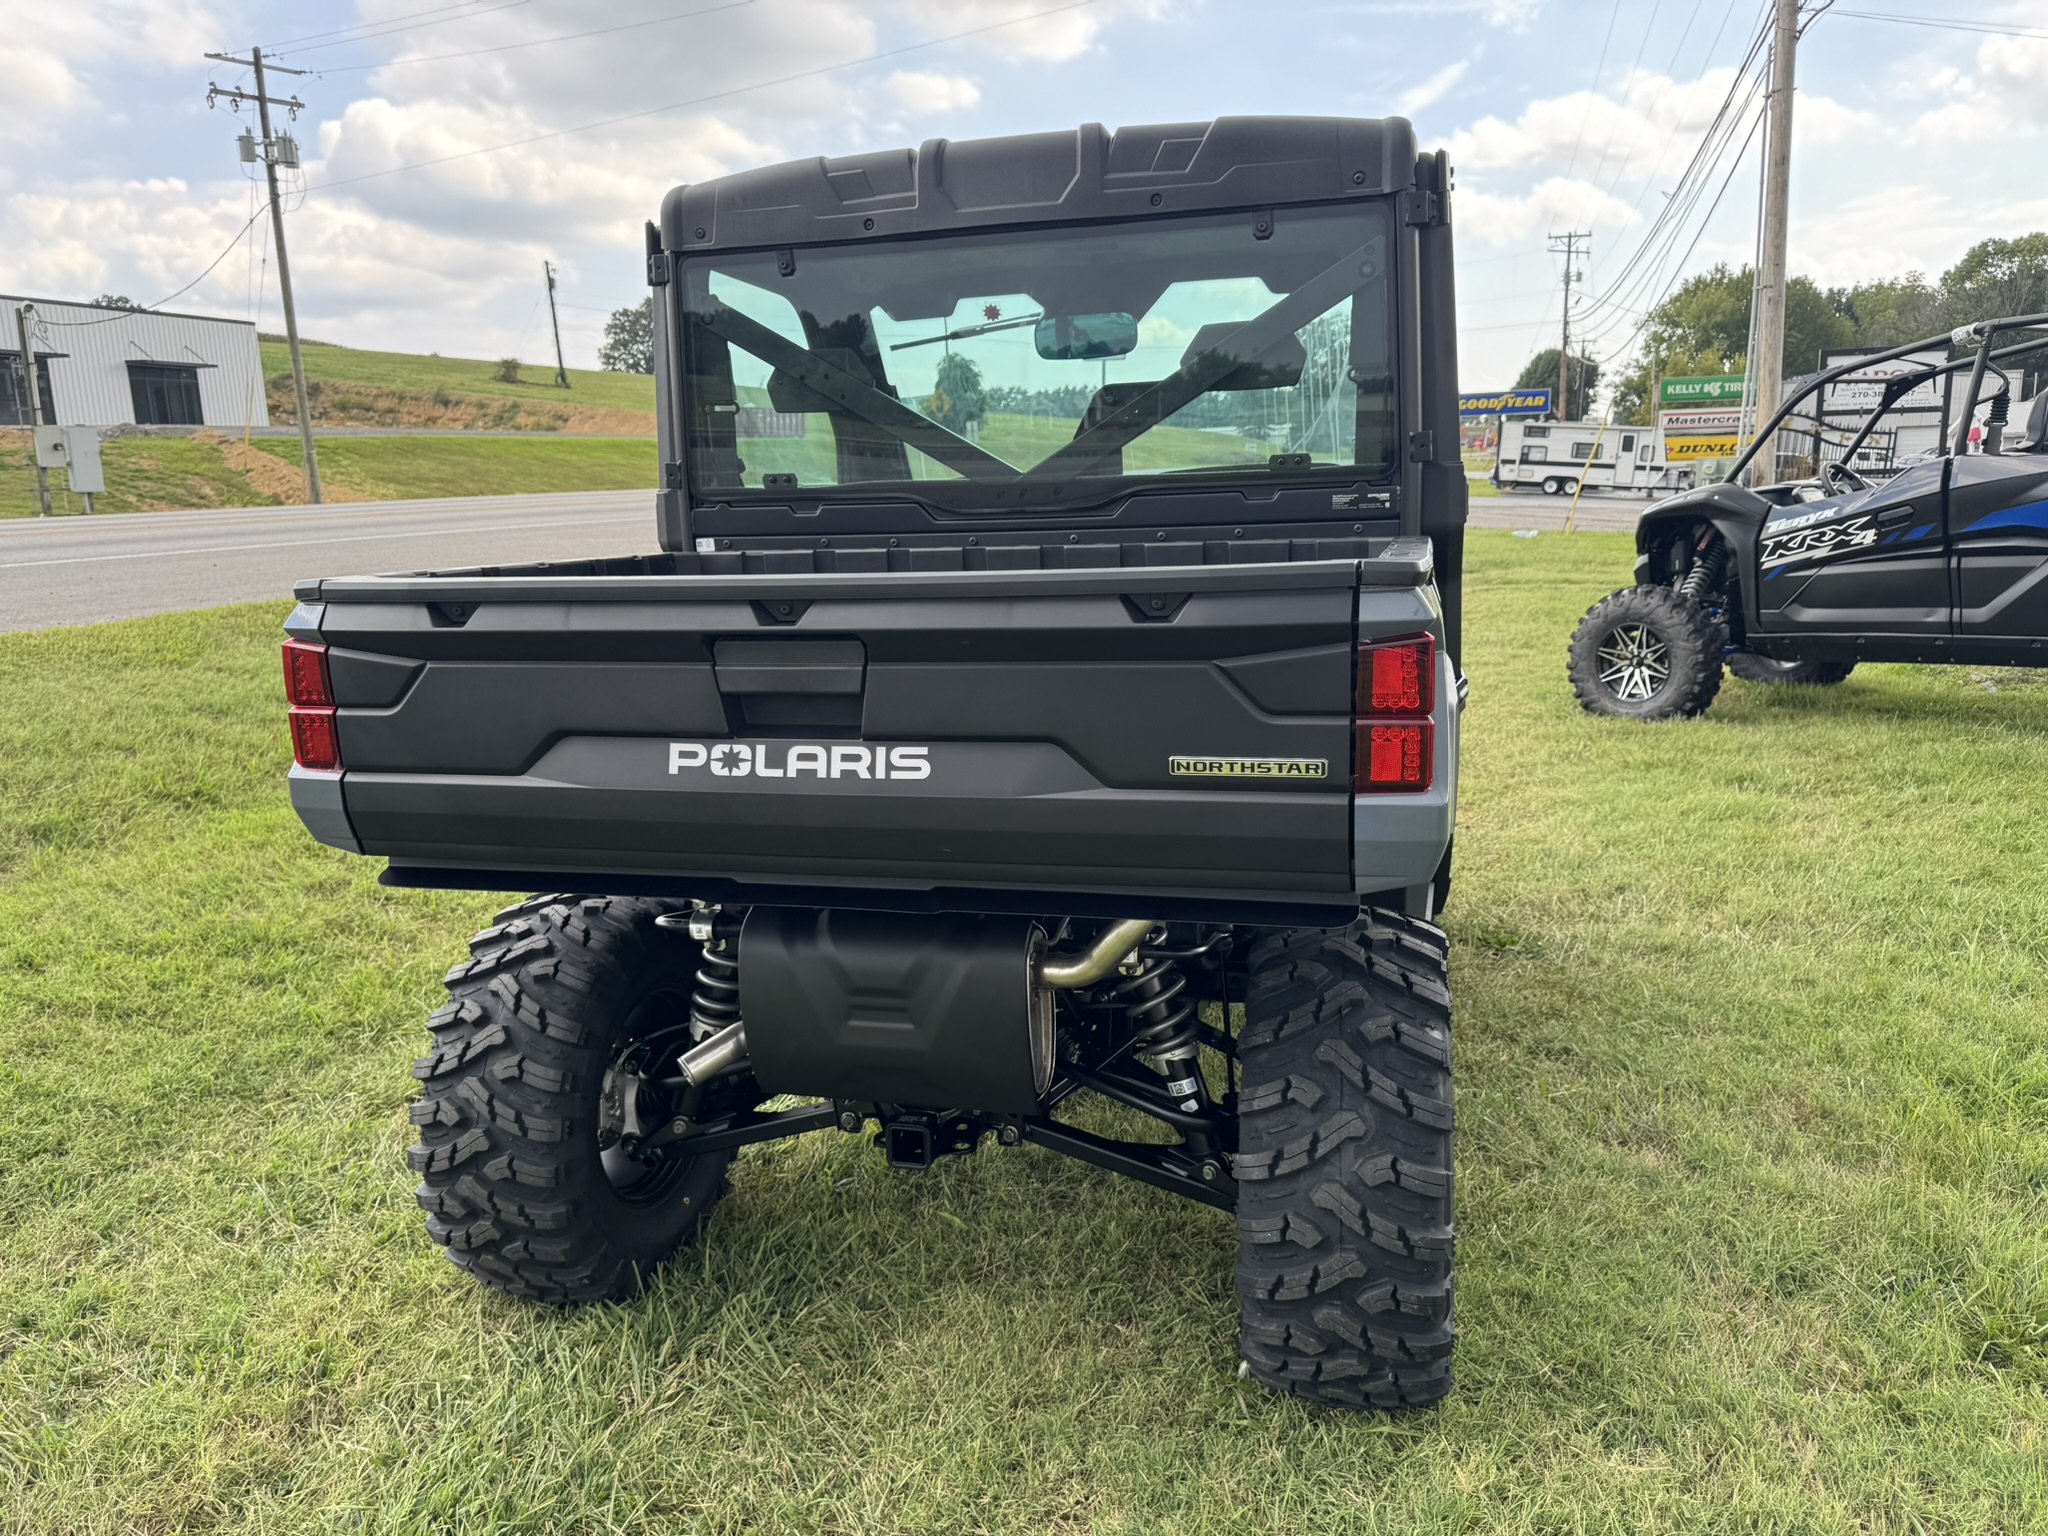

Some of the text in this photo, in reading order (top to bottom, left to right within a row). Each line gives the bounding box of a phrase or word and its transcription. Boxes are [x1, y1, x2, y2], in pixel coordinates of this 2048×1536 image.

[1667, 384, 1702, 394] KELLY
[1459, 394, 1546, 411] GOODYEAR
[668, 743, 931, 780] POLARIS
[1175, 760, 1321, 775] NORTHSTAR
